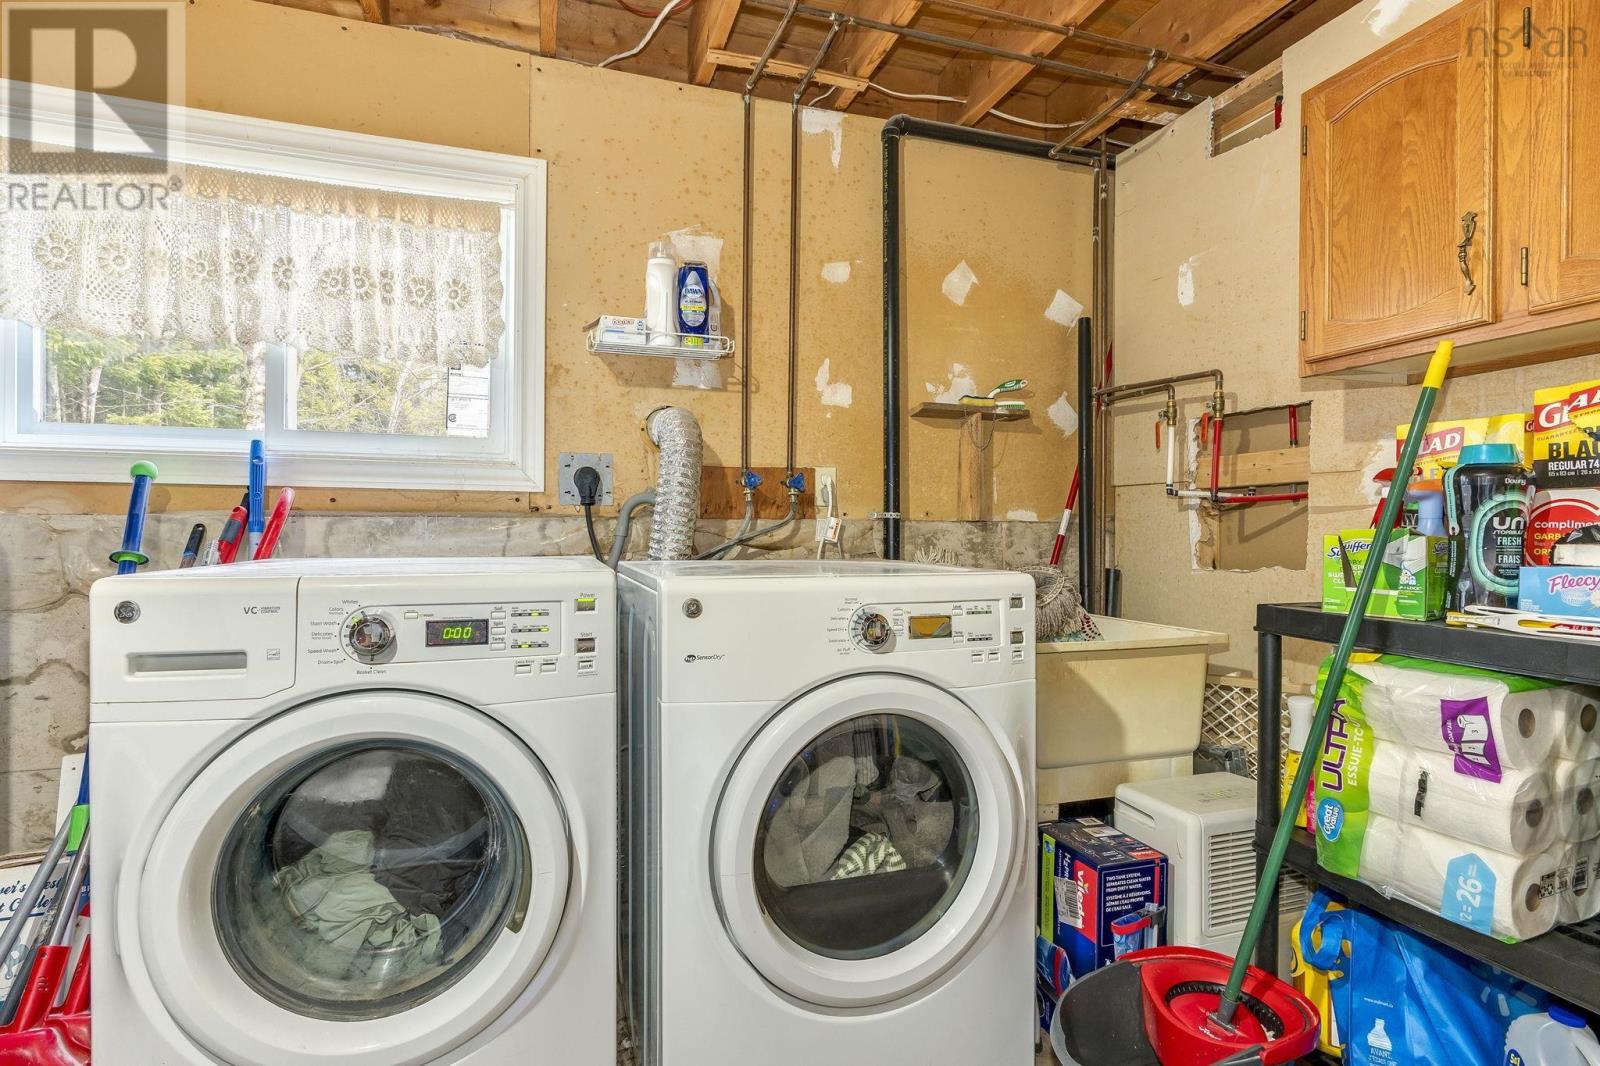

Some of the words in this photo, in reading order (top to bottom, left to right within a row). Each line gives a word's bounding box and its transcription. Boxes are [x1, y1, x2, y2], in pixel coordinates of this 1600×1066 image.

[1538, 388, 1600, 428] GLA
[1400, 431, 1461, 456] LAD
[1548, 460, 1587, 471] REGULAR
[1588, 459, 1599, 469] 74
[1504, 477, 1527, 485] Downy
[1534, 519, 1600, 530] complim
[1497, 537, 1522, 545] FRESH
[1498, 555, 1520, 563] FRAIS
[1548, 573, 1600, 594] Fleecy
[243, 606, 258, 614] VC
[443, 627, 472, 639] 0:00
[1321, 698, 1349, 793] ULTRA
[1323, 804, 1334, 835] Great
